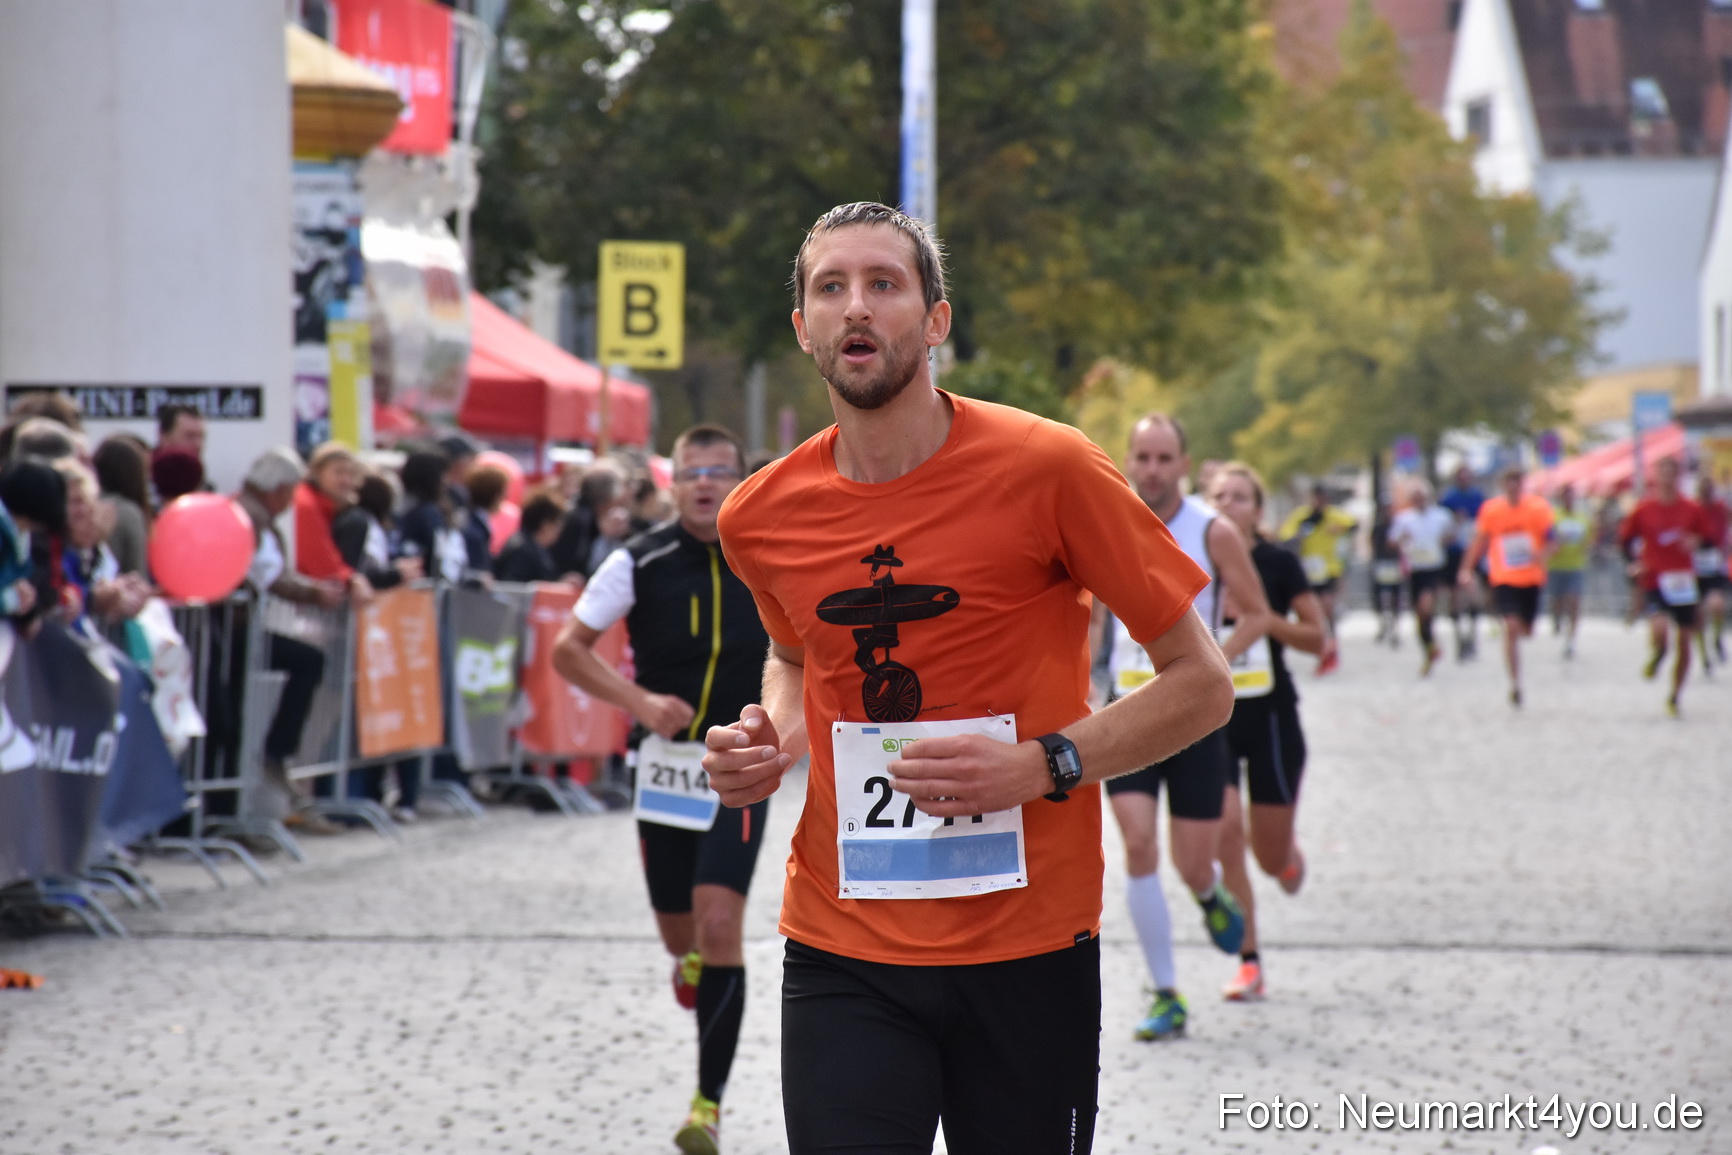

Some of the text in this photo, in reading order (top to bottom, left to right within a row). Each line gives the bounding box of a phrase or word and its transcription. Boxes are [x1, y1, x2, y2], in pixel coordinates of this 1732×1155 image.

[623, 282, 660, 337] B
[649, 761, 710, 793] 2714
[848, 822, 855, 832] D
